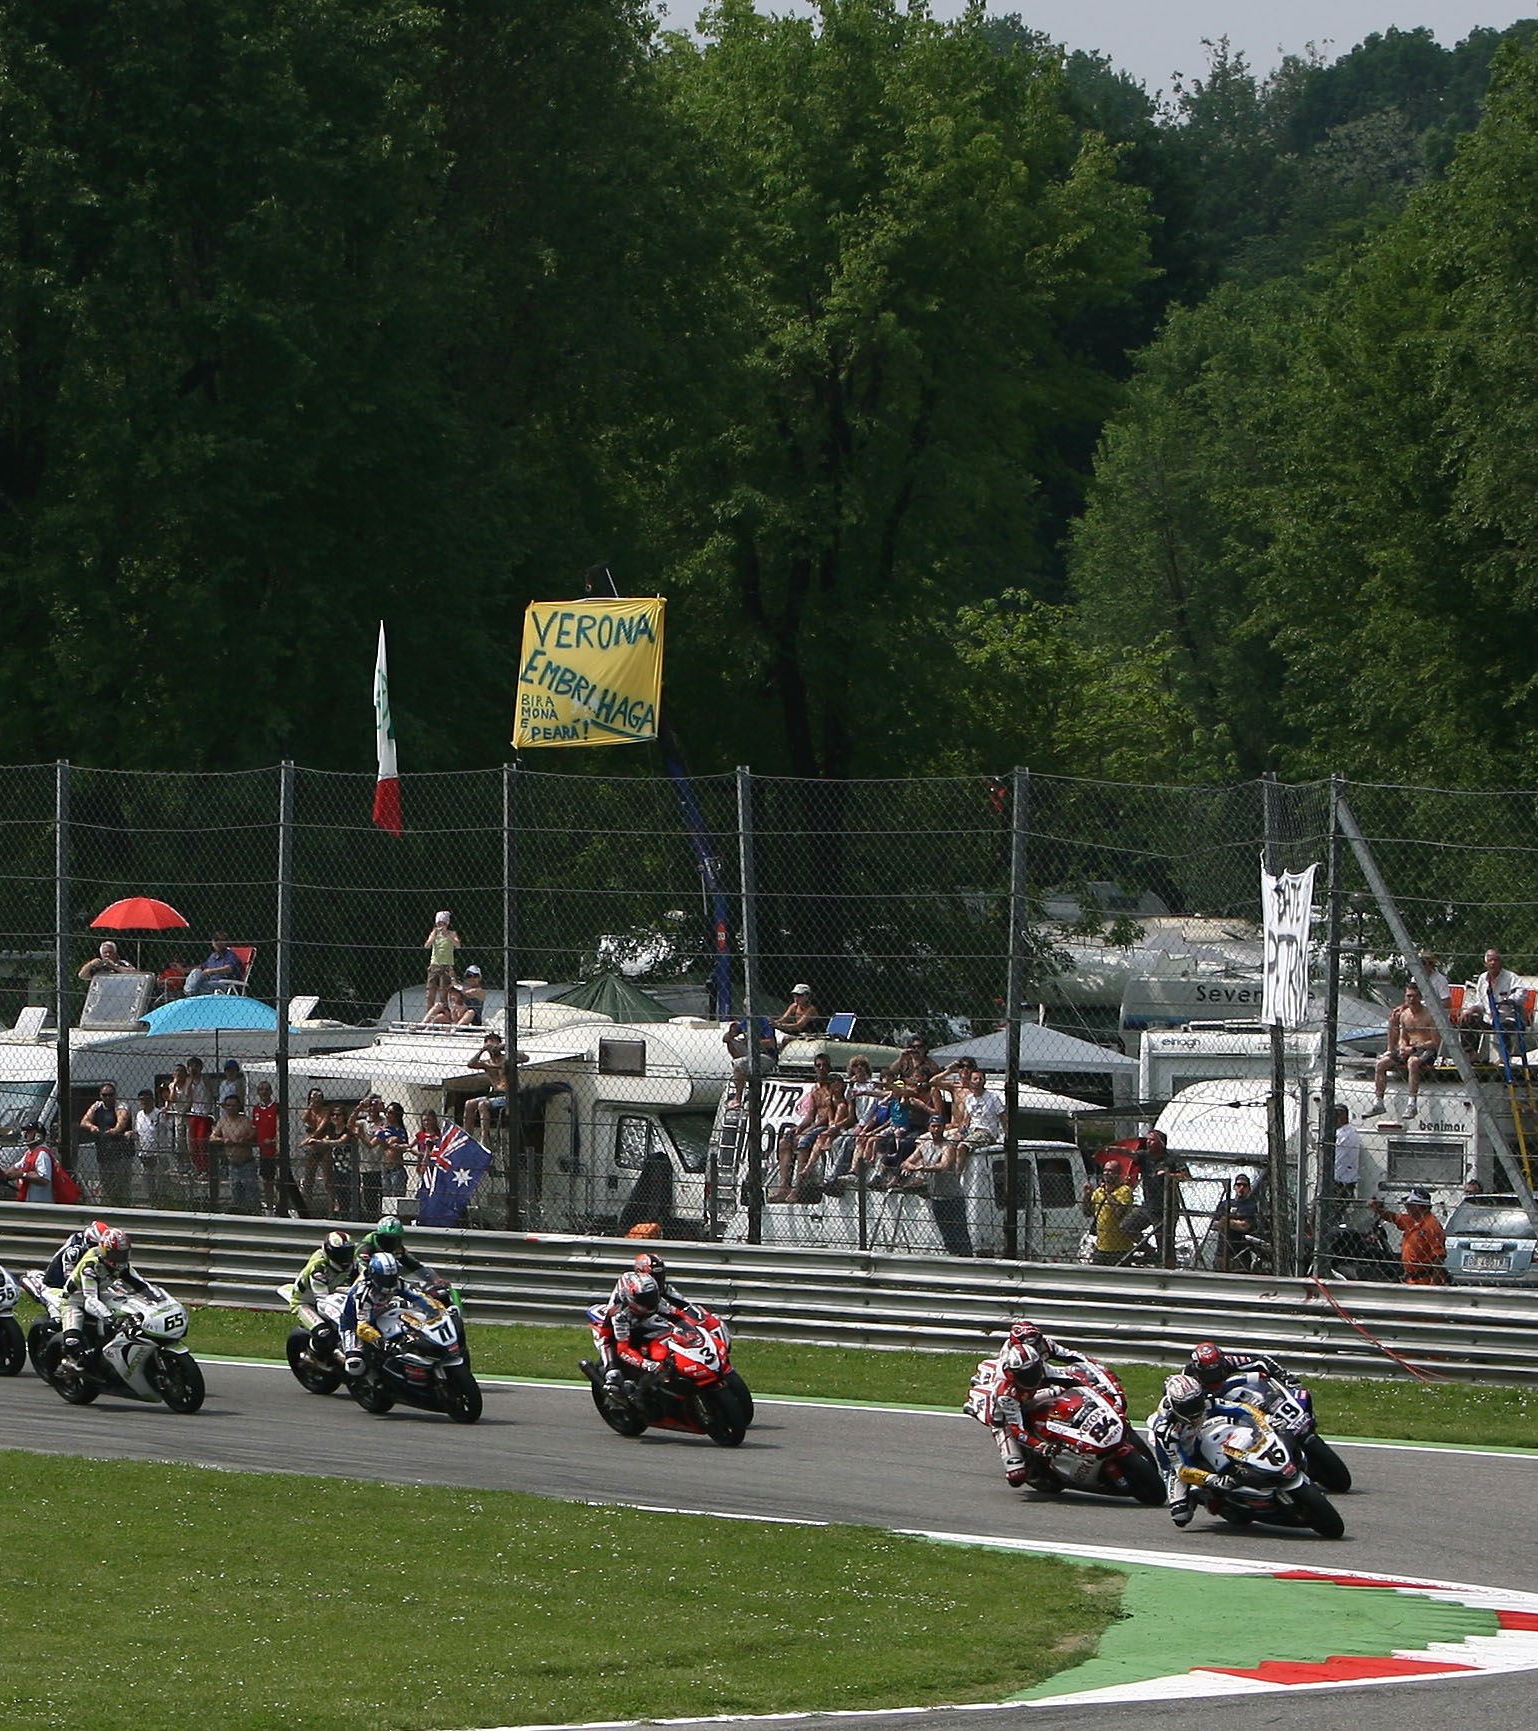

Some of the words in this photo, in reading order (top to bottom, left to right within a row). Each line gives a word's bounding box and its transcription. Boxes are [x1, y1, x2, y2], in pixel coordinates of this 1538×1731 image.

[531, 610, 656, 650] VERONA
[521, 693, 555, 707] BIRA
[596, 687, 657, 733] HAGA
[522, 706, 559, 721] MONA
[1419, 1119, 1466, 1134] benimar
[164, 1312, 185, 1332] 65
[429, 1321, 455, 1344] 71
[699, 1346, 717, 1366] 3
[1077, 1409, 1102, 1439] xerox
[1257, 1440, 1287, 1467] 76
